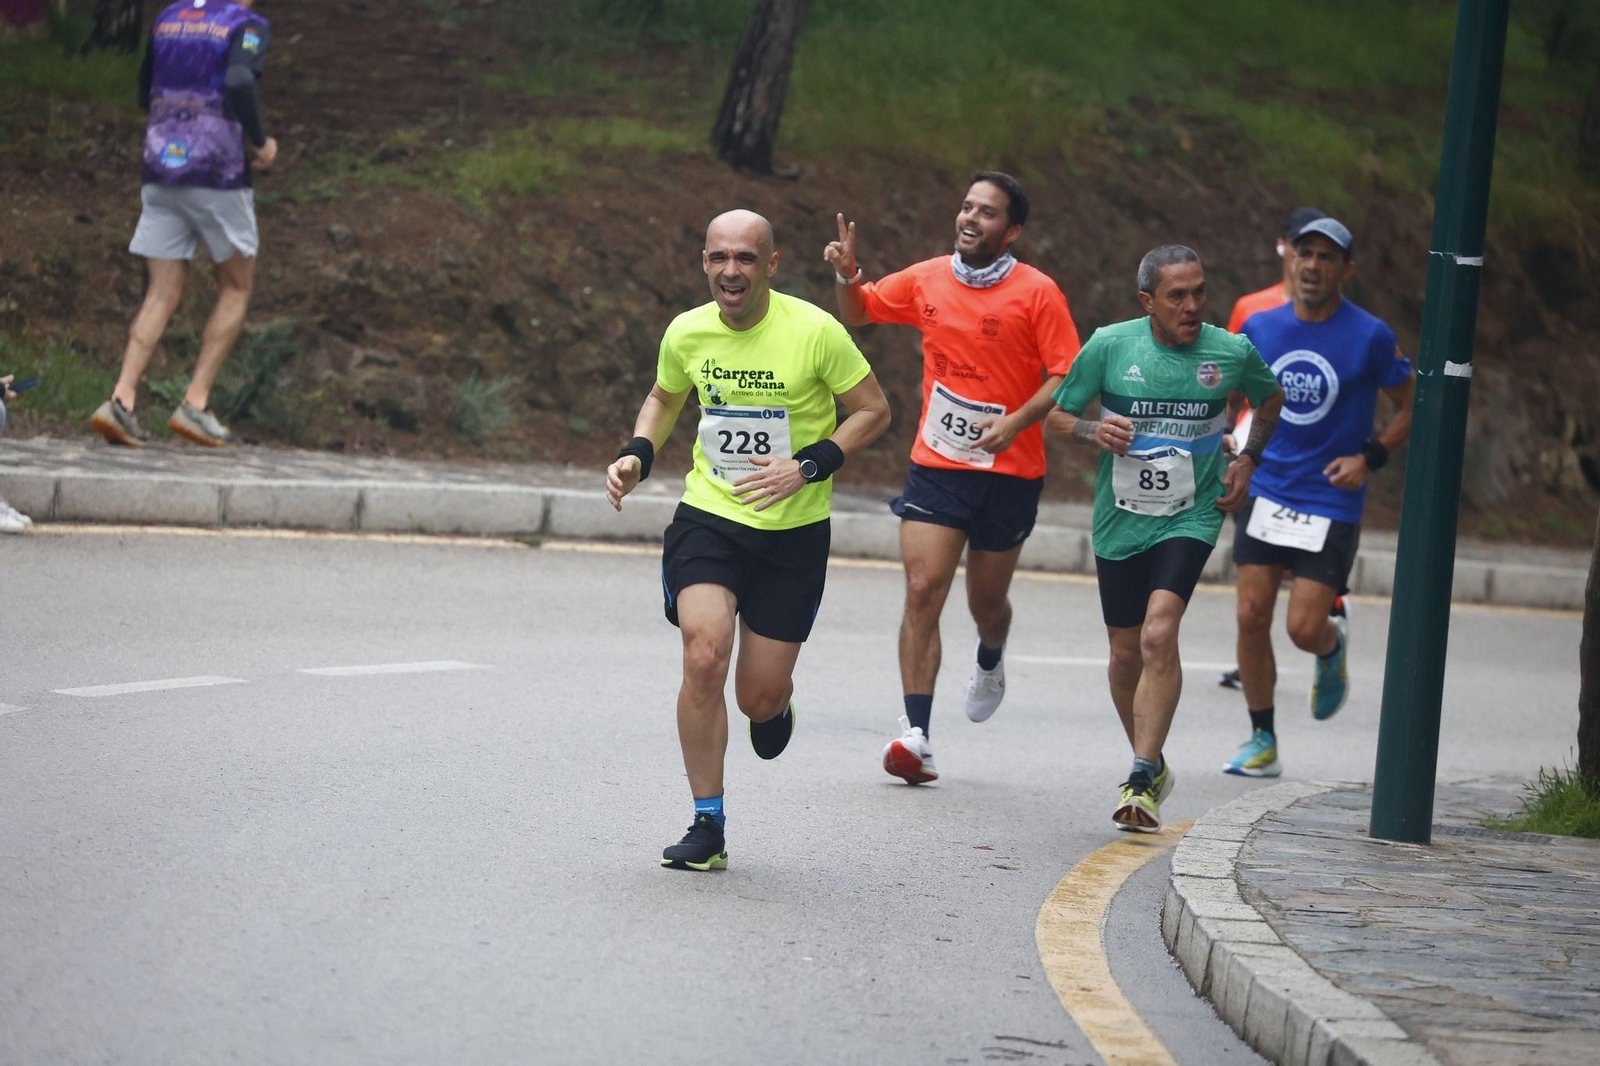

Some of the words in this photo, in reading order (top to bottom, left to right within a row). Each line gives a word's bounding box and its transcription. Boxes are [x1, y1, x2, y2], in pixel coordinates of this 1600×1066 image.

[712, 367, 774, 380] Carrera
[1281, 370, 1322, 390] RCM
[738, 378, 785, 390] Urbana
[1283, 386, 1321, 405] 1873
[1129, 401, 1209, 417] ATLETISMO
[940, 412, 984, 441] 439
[1133, 421, 1212, 438] RREMOLINOS
[718, 430, 771, 455] 228
[1139, 469, 1170, 491] 83
